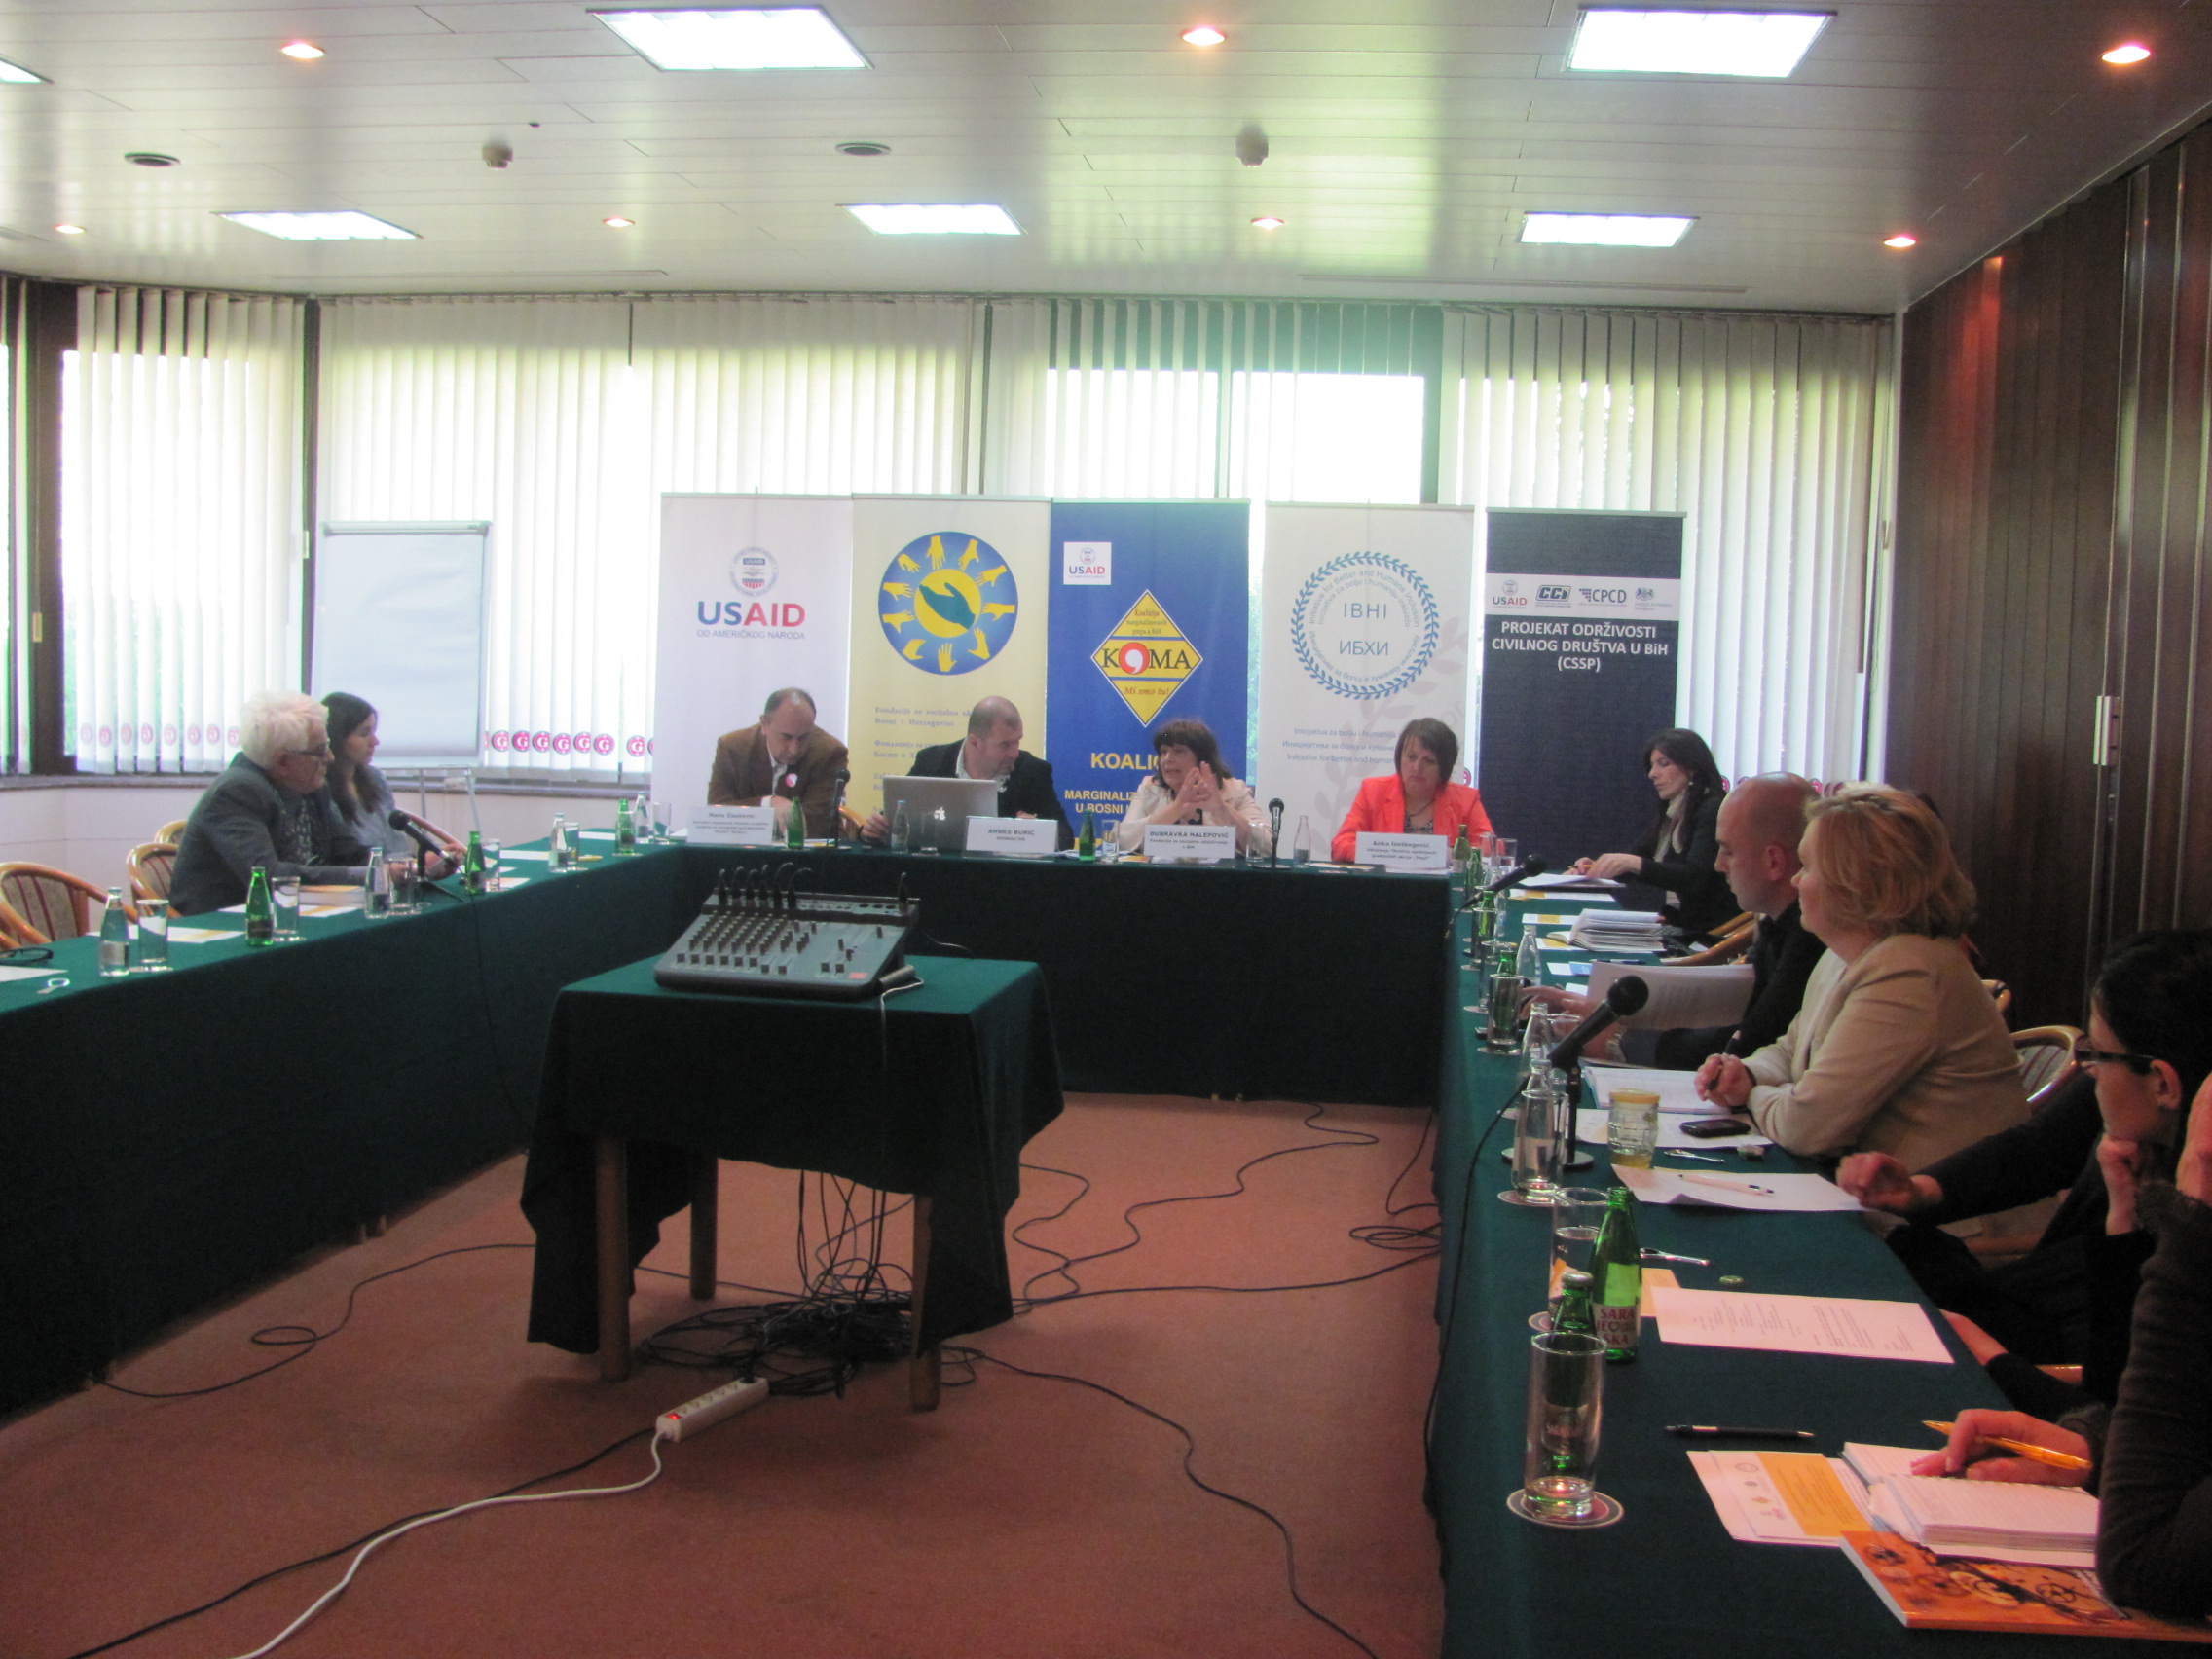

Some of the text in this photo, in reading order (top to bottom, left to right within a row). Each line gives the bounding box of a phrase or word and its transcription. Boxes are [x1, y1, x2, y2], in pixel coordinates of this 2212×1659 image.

[1069, 566, 1106, 574] USAID
[1334, 571, 1356, 584] Better
[1377, 571, 1406, 593] Humane
[1405, 593, 1419, 627] Inclusion
[1493, 596, 1527, 606] USAID
[1593, 589, 1627, 603] CPCD
[697, 601, 806, 627] USAID
[1344, 603, 1387, 619] IBHI
[696, 628, 806, 640] OD AMERIČKOG NARODA
[1501, 621, 1656, 639] PROJEKAT ODRŽIVOSTI
[1339, 641, 1389, 656] ИБХИ
[1492, 638, 1669, 655] CIVILNOG DRUŠTVA U BiH
[1102, 643, 1193, 675] KOMA
[1558, 657, 1601, 673] (CSSP)
[1124, 686, 1136, 695] Mi
[909, 719, 955, 727] Hercegovini
[1287, 754, 1318, 762] Initiative
[1075, 803, 1084, 813] U
[1088, 803, 1124, 814] BOSNI
[1600, 1308, 1635, 1320] SARA
[1604, 1334, 1629, 1346] SKA
